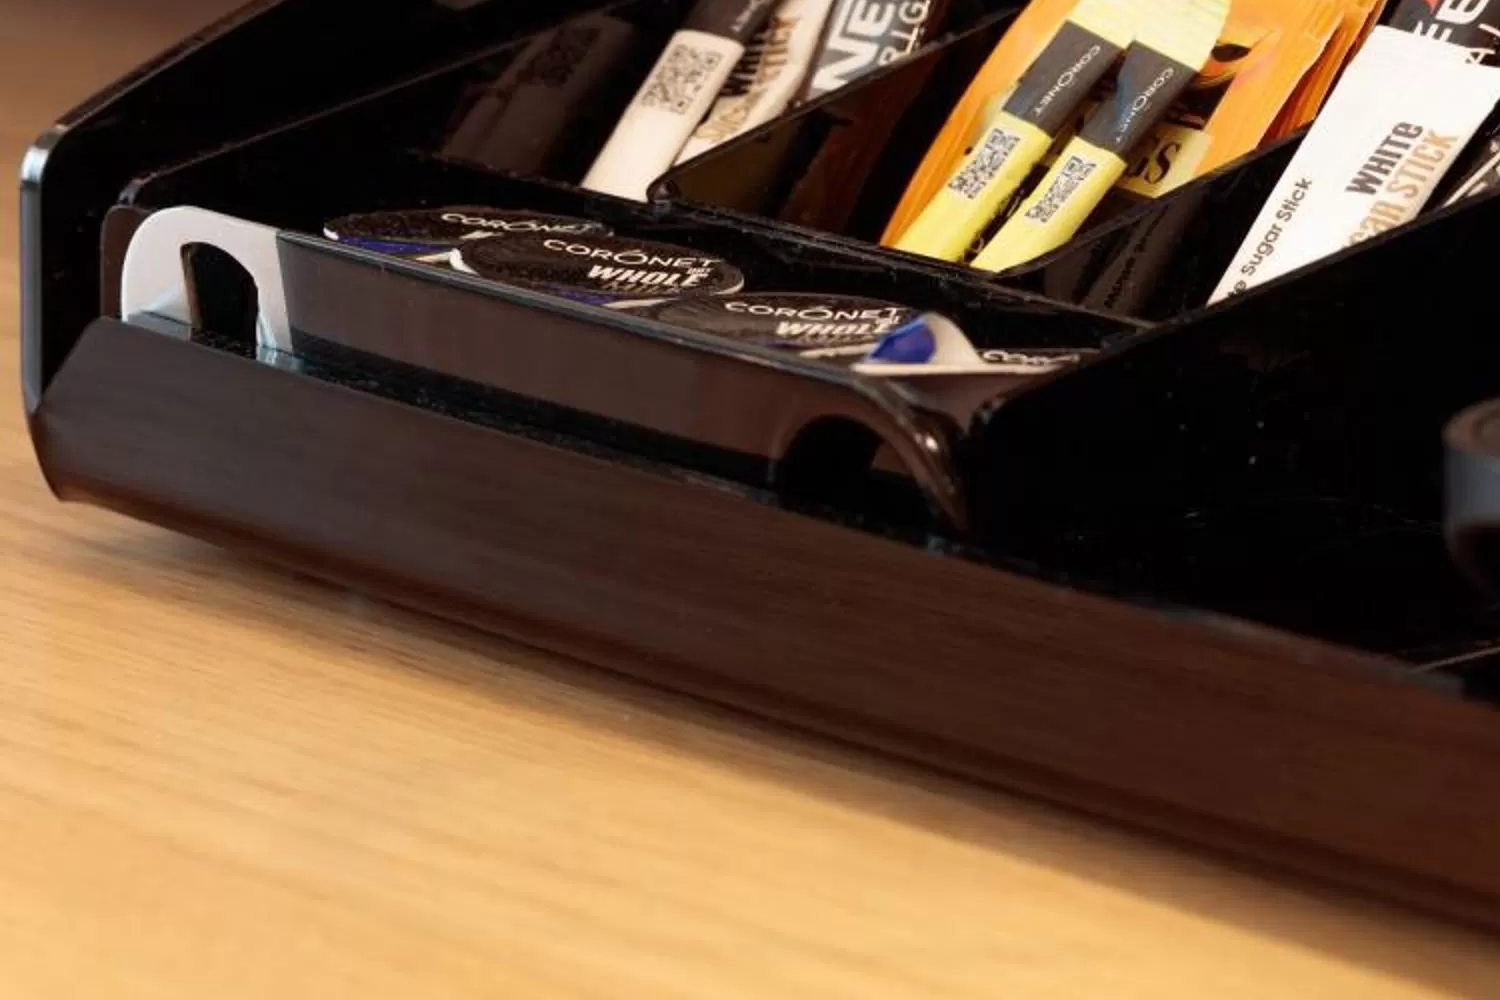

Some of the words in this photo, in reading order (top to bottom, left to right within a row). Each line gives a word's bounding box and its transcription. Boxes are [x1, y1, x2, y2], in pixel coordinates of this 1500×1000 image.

[1034, 45, 1101, 117] CORONET
[1386, 128, 1459, 199] STICK
[543, 239, 722, 267] CORONET
[1240, 221, 1284, 277] Sugar
[1275, 176, 1313, 223] Stick
[587, 265, 709, 288] WHOLE
